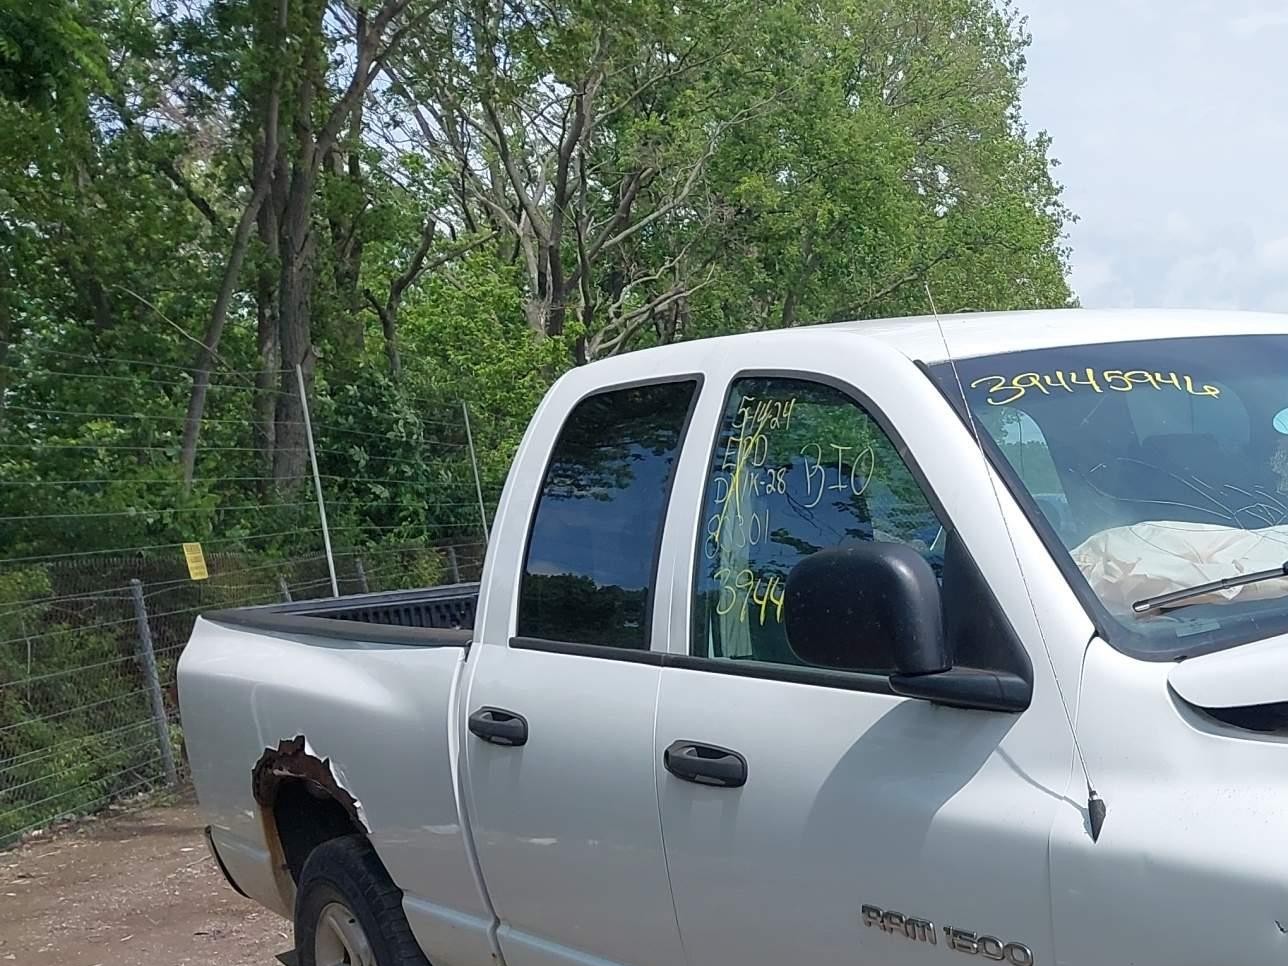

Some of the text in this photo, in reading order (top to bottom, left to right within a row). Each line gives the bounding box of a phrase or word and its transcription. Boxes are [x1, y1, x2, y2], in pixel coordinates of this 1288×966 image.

[970, 367, 1221, 406] 39445946
[800, 442, 876, 508] BIO
[861, 903, 938, 945] RAM
